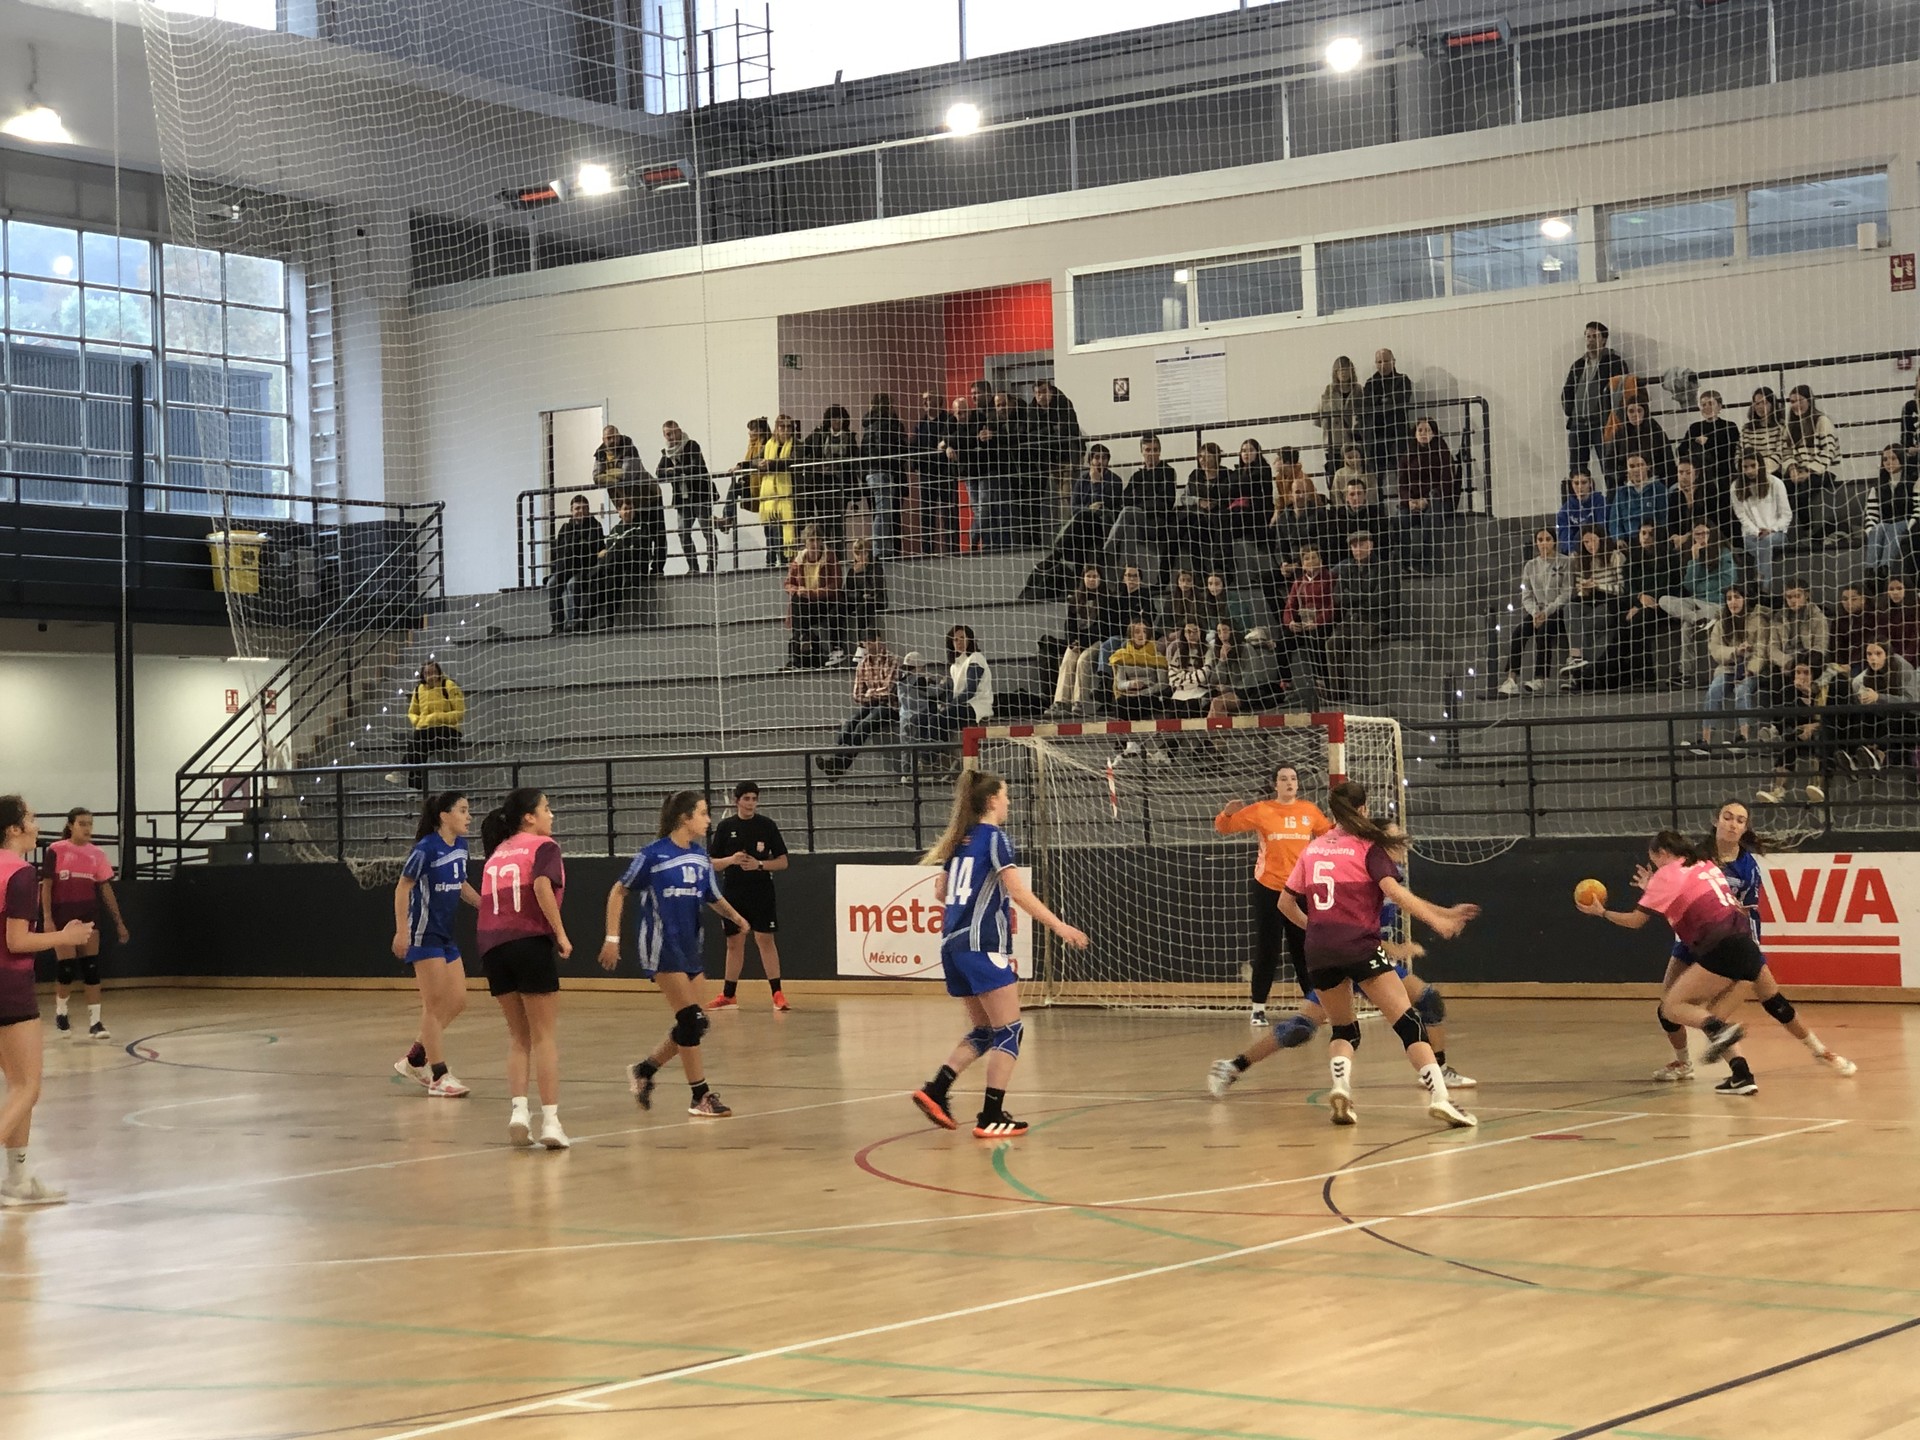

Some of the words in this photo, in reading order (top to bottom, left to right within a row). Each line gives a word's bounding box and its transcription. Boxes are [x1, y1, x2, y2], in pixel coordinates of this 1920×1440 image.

[486, 863, 521, 915] 17
[945, 856, 975, 906] 14
[1312, 860, 1336, 911] 5
[869, 951, 908, 965] México
